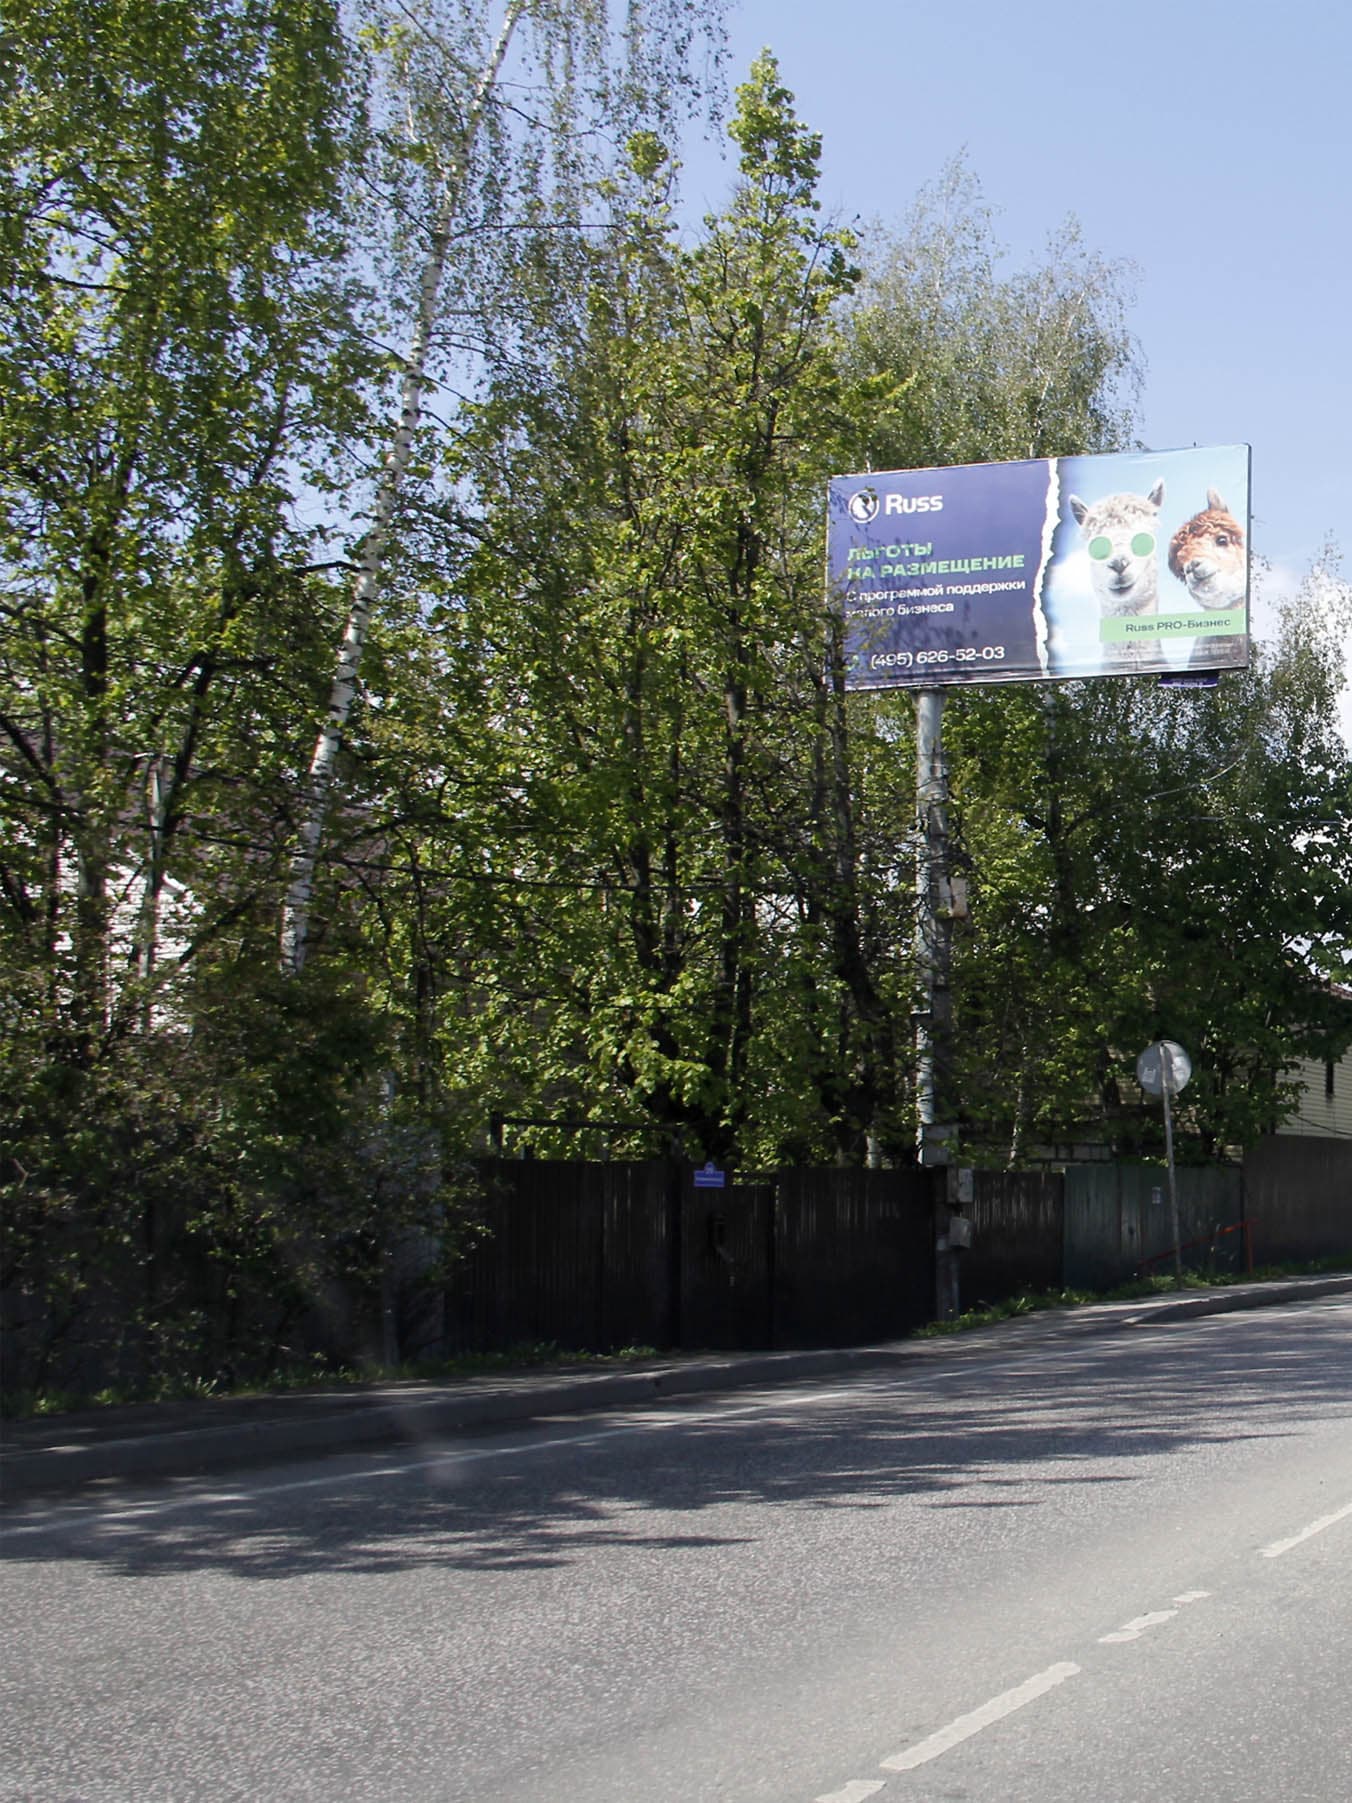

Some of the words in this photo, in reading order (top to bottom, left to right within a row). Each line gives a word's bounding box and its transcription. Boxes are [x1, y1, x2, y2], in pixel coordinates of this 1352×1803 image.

[885, 494, 943, 515] Russ
[847, 542, 933, 561] ЛЬГОТЫ
[847, 566, 876, 580] НА
[880, 554, 1025, 578] РАЗМЕЩЕНИЕ
[859, 583, 944, 603] программой
[946, 579, 1026, 596] поддержки
[897, 602, 954, 615] бизнеса
[1125, 623, 1155, 633] Russ
[1156, 618, 1231, 631] PRO-Бизнес
[871, 651, 914, 670] (495)
[916, 646, 1006, 665] 626-52-03
